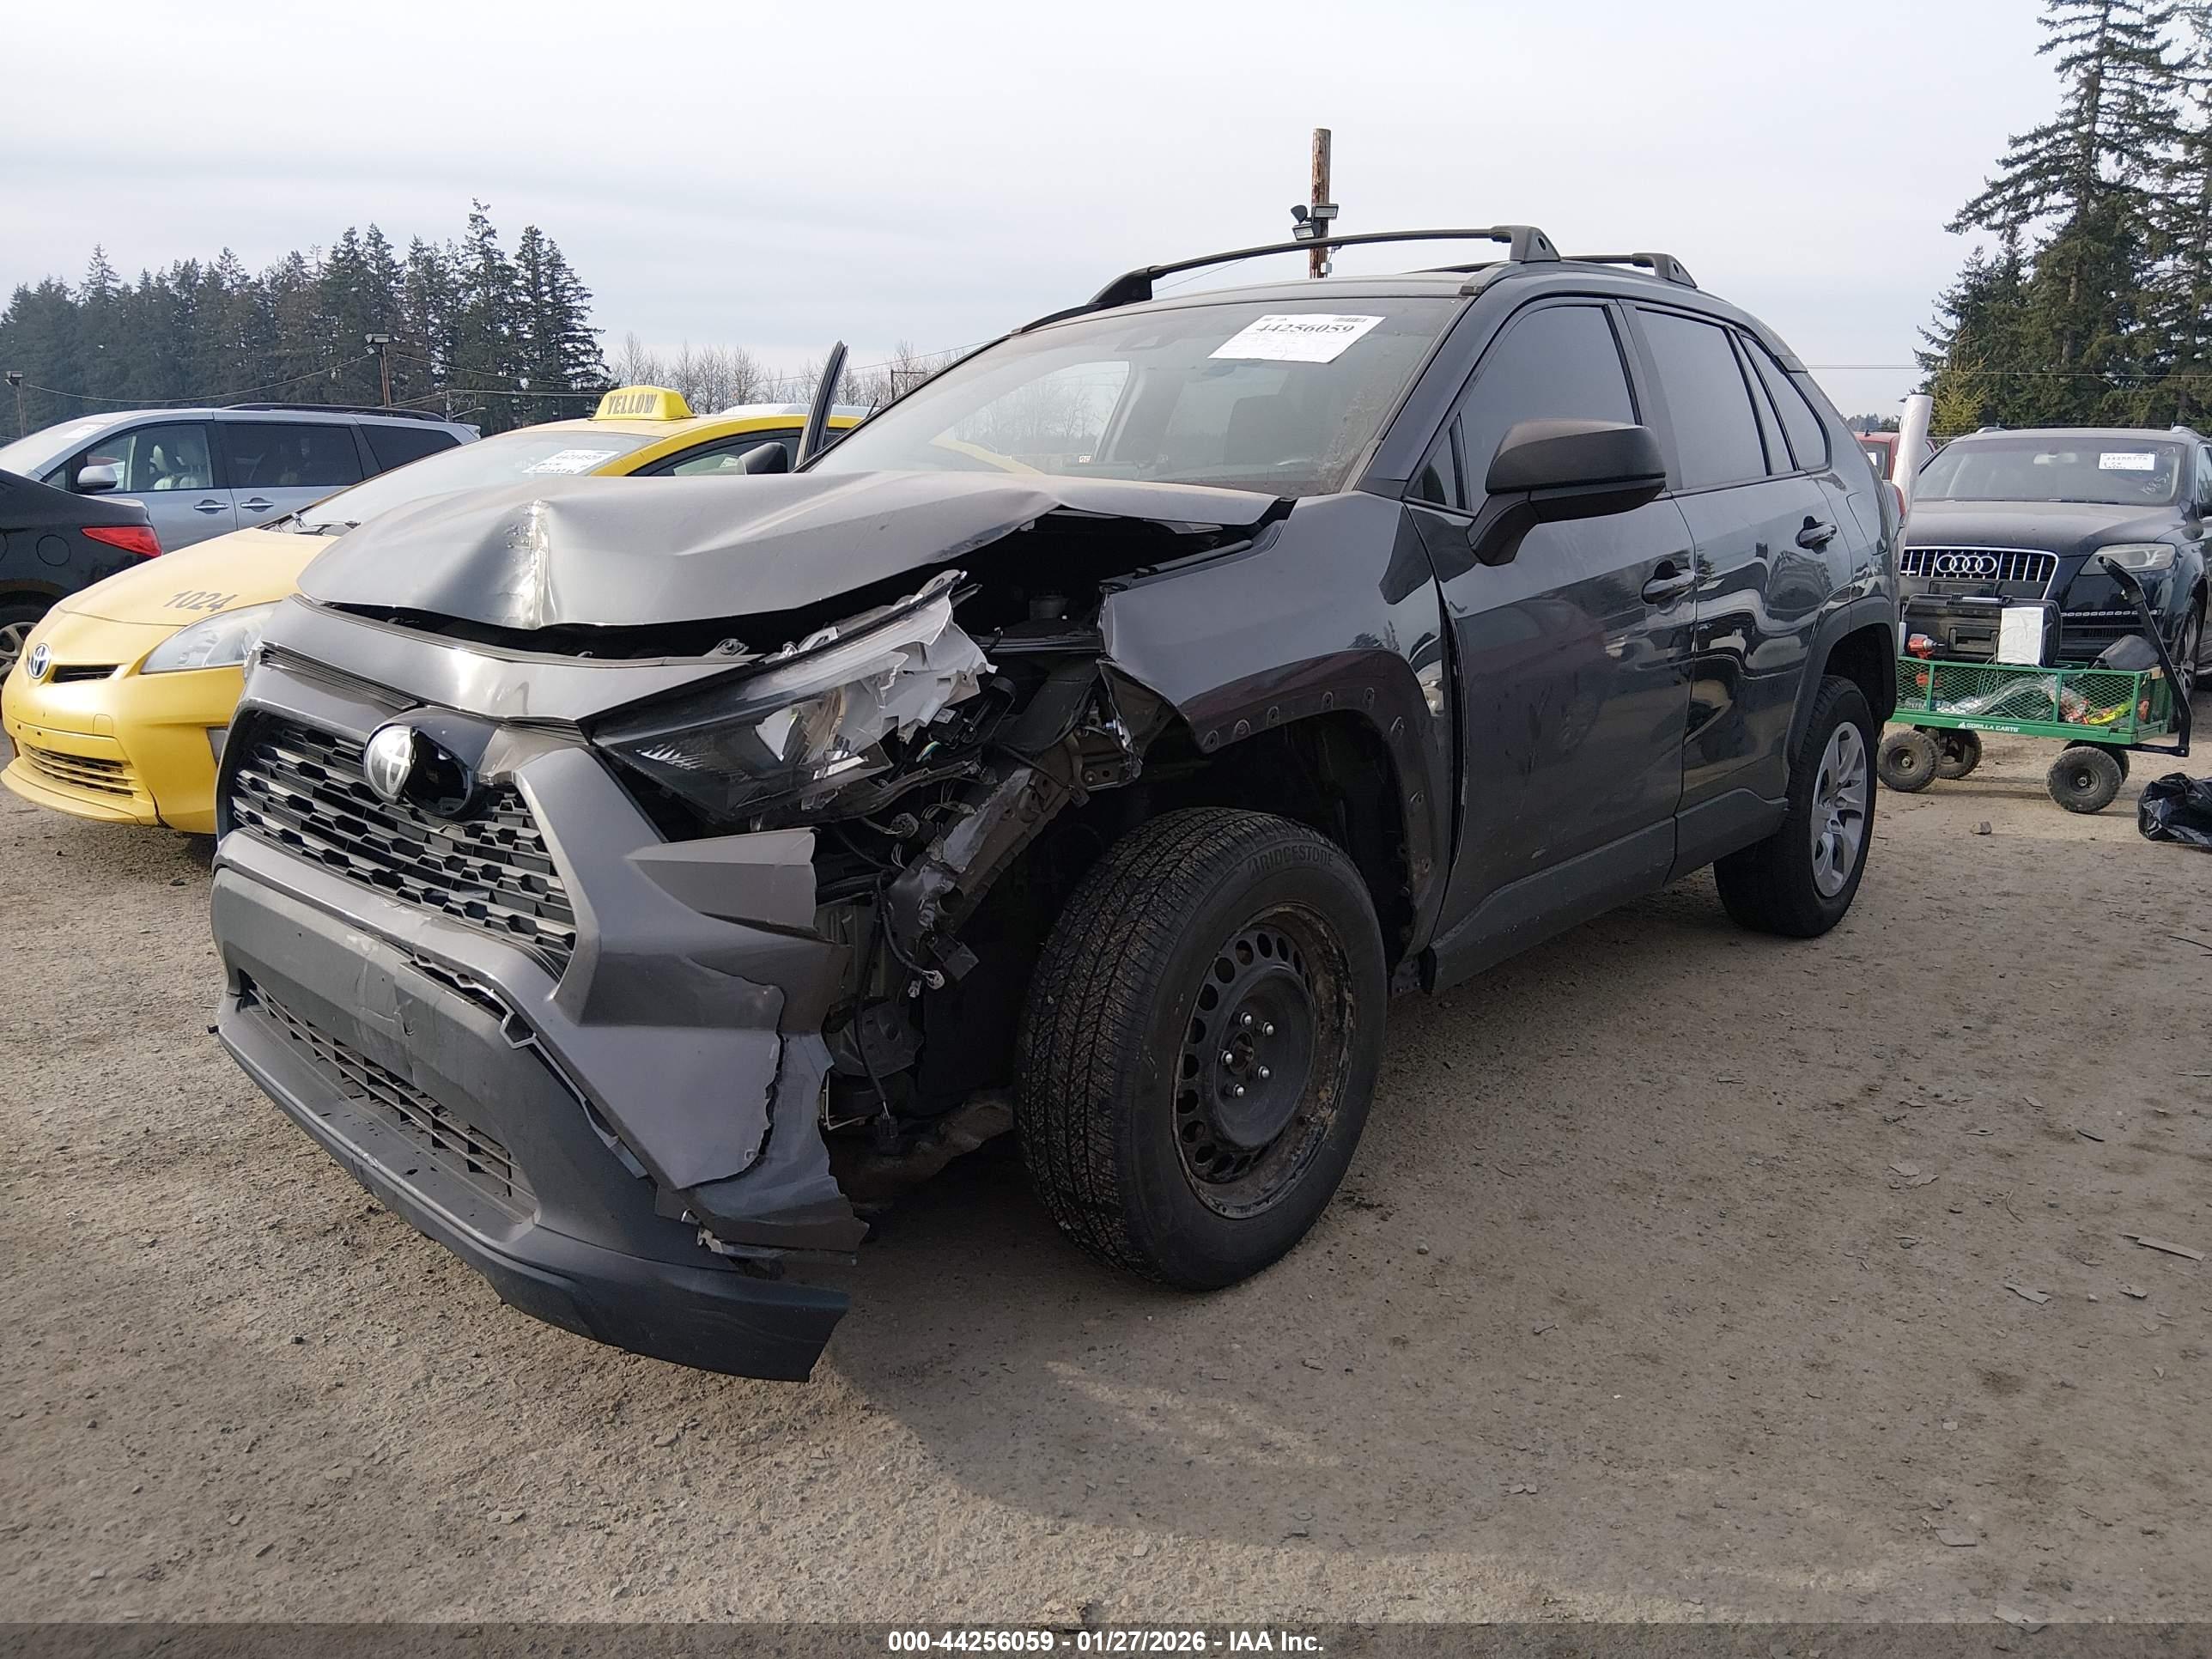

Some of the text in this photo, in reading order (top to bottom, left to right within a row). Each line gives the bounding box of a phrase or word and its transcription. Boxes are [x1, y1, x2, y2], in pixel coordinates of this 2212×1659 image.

[1256, 323, 1356, 334] 44256059
[606, 393, 658, 416] YELLOW
[162, 590, 239, 612] 1024
[1966, 722, 1994, 731] GORILLA
[1248, 844, 1334, 876] BRIDGESTONE
